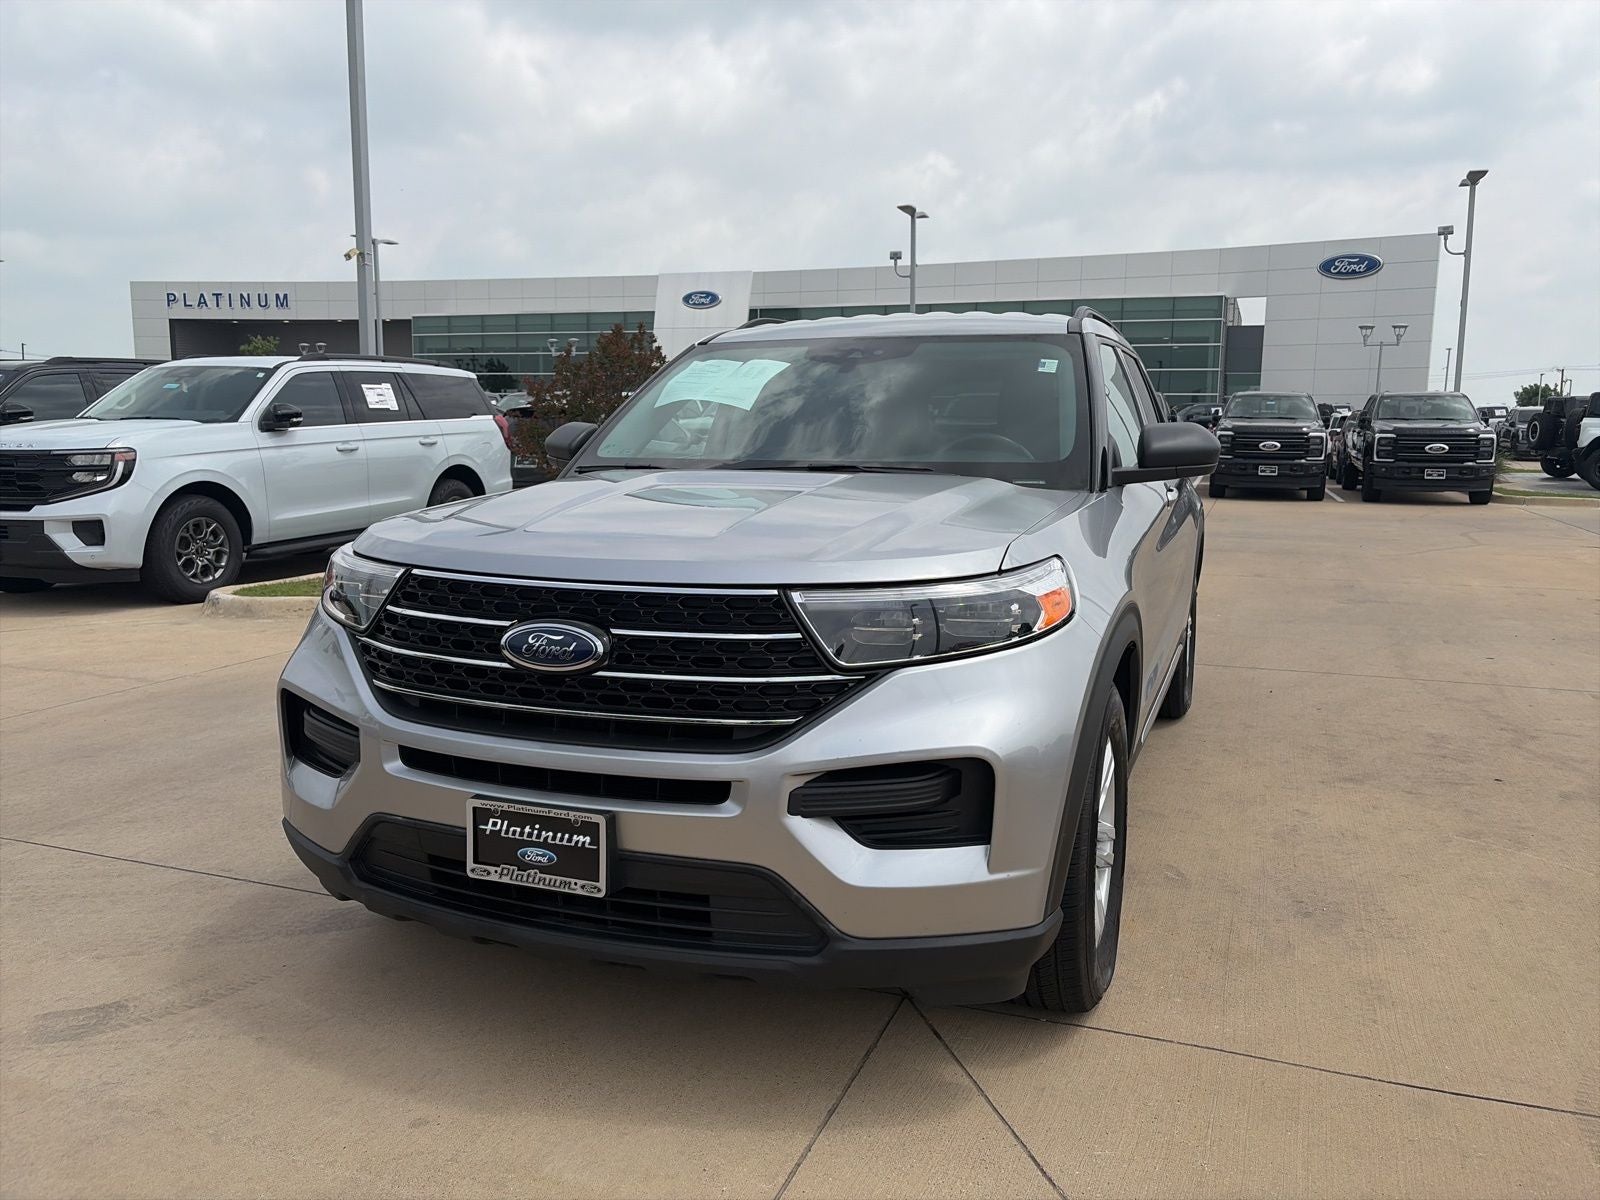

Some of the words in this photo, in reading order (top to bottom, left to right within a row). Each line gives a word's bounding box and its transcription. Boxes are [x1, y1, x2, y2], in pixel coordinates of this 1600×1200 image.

[1330, 258, 1369, 273] Ford
[166, 292, 290, 309] PLATINUM
[688, 293, 712, 304] Ford
[522, 632, 577, 661] Ford
[480, 801, 593, 821] www.PlatinumFord.com
[478, 817, 598, 849] Platinum
[524, 849, 549, 864] Ford
[498, 865, 579, 892] Platinum
